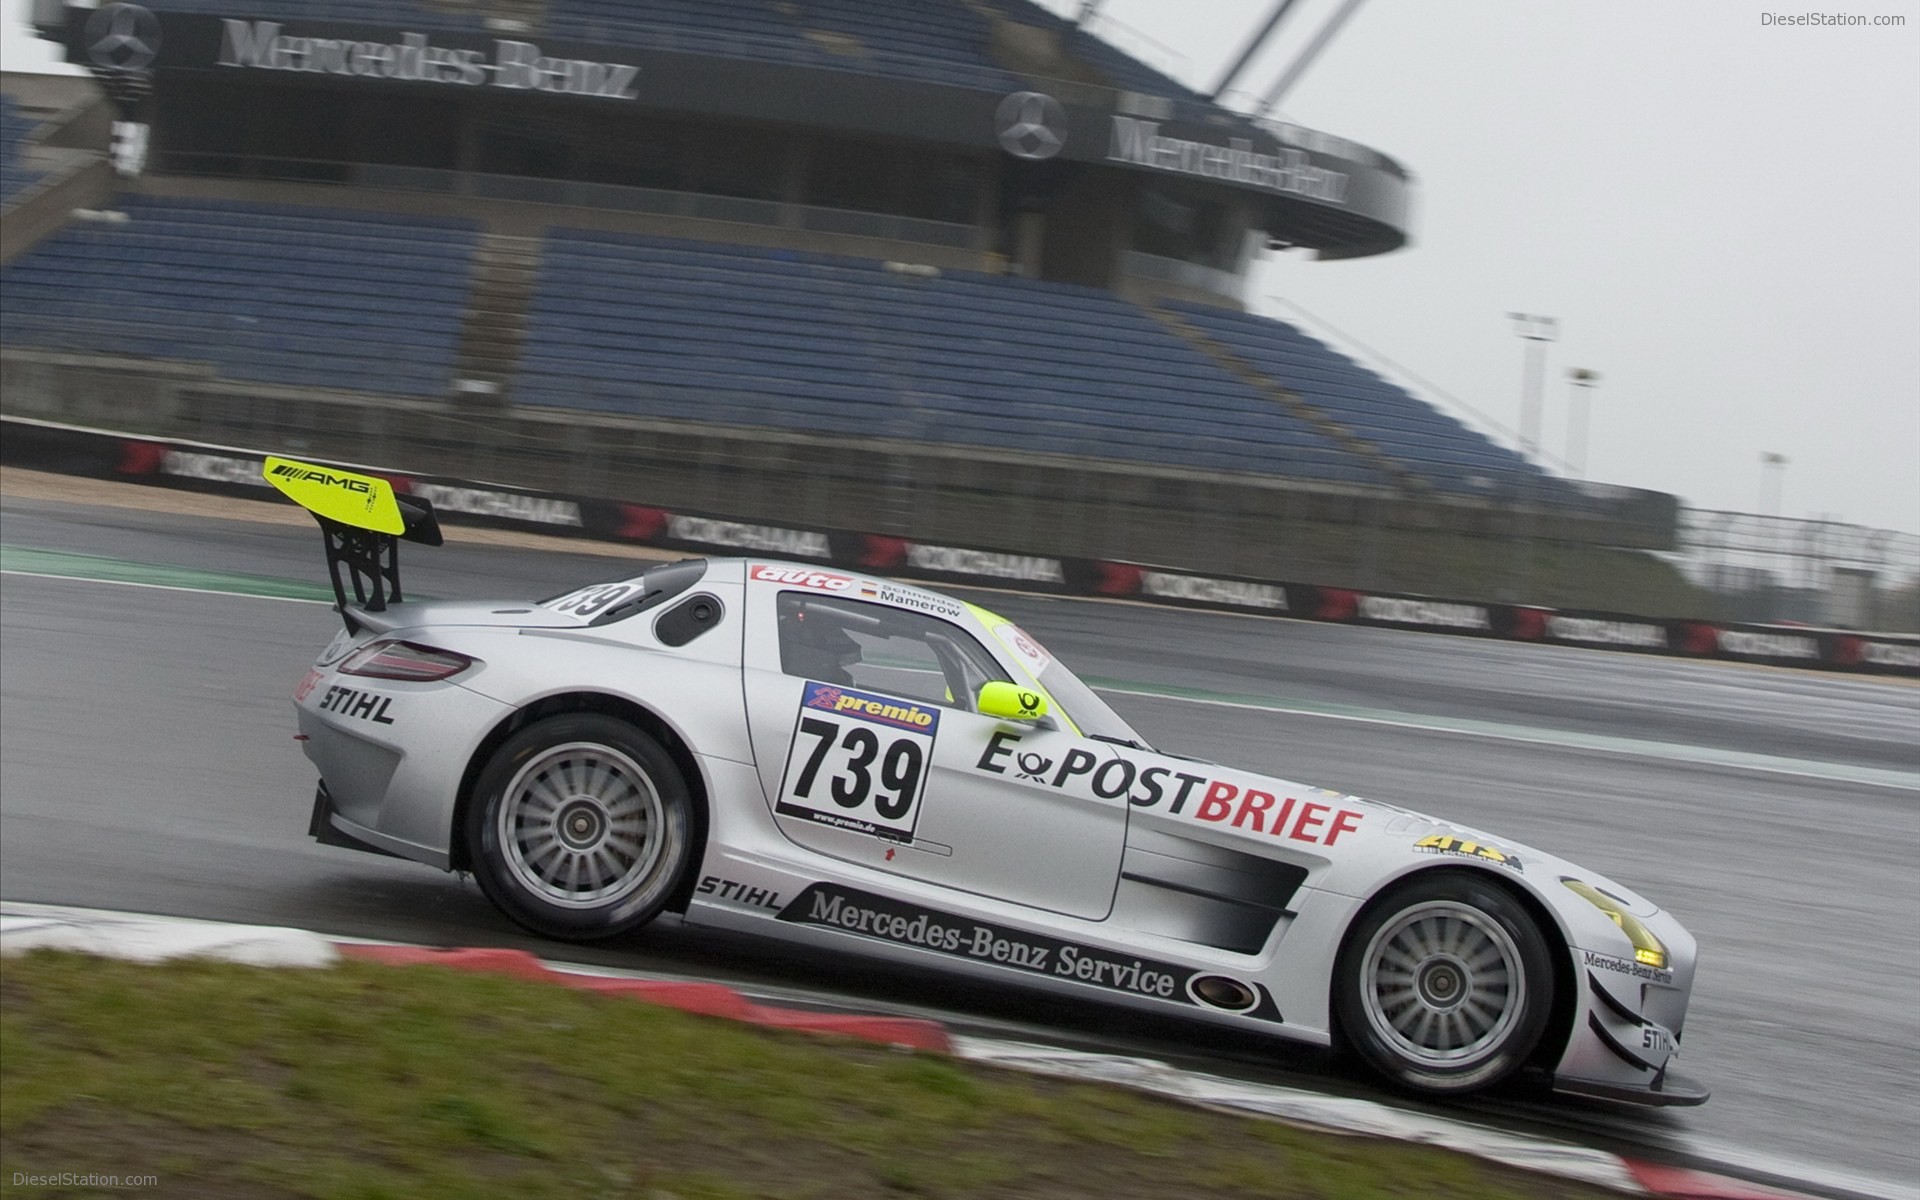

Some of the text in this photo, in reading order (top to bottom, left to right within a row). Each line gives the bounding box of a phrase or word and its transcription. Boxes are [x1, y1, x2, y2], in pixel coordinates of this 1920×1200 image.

[216, 17, 640, 99] Mercedes-Benz
[302, 471, 371, 494] AMG
[756, 567, 852, 591] auto
[880, 590, 961, 617] Mamerow
[319, 685, 395, 725] STIHL
[833, 694, 933, 727] premio
[793, 716, 924, 820] 739
[813, 813, 876, 832] www.premio.de
[697, 876, 784, 911] STIHL
[808, 890, 1176, 997] Mercedes-Benz Service
[1584, 951, 1652, 980] Mercedes-Benz
